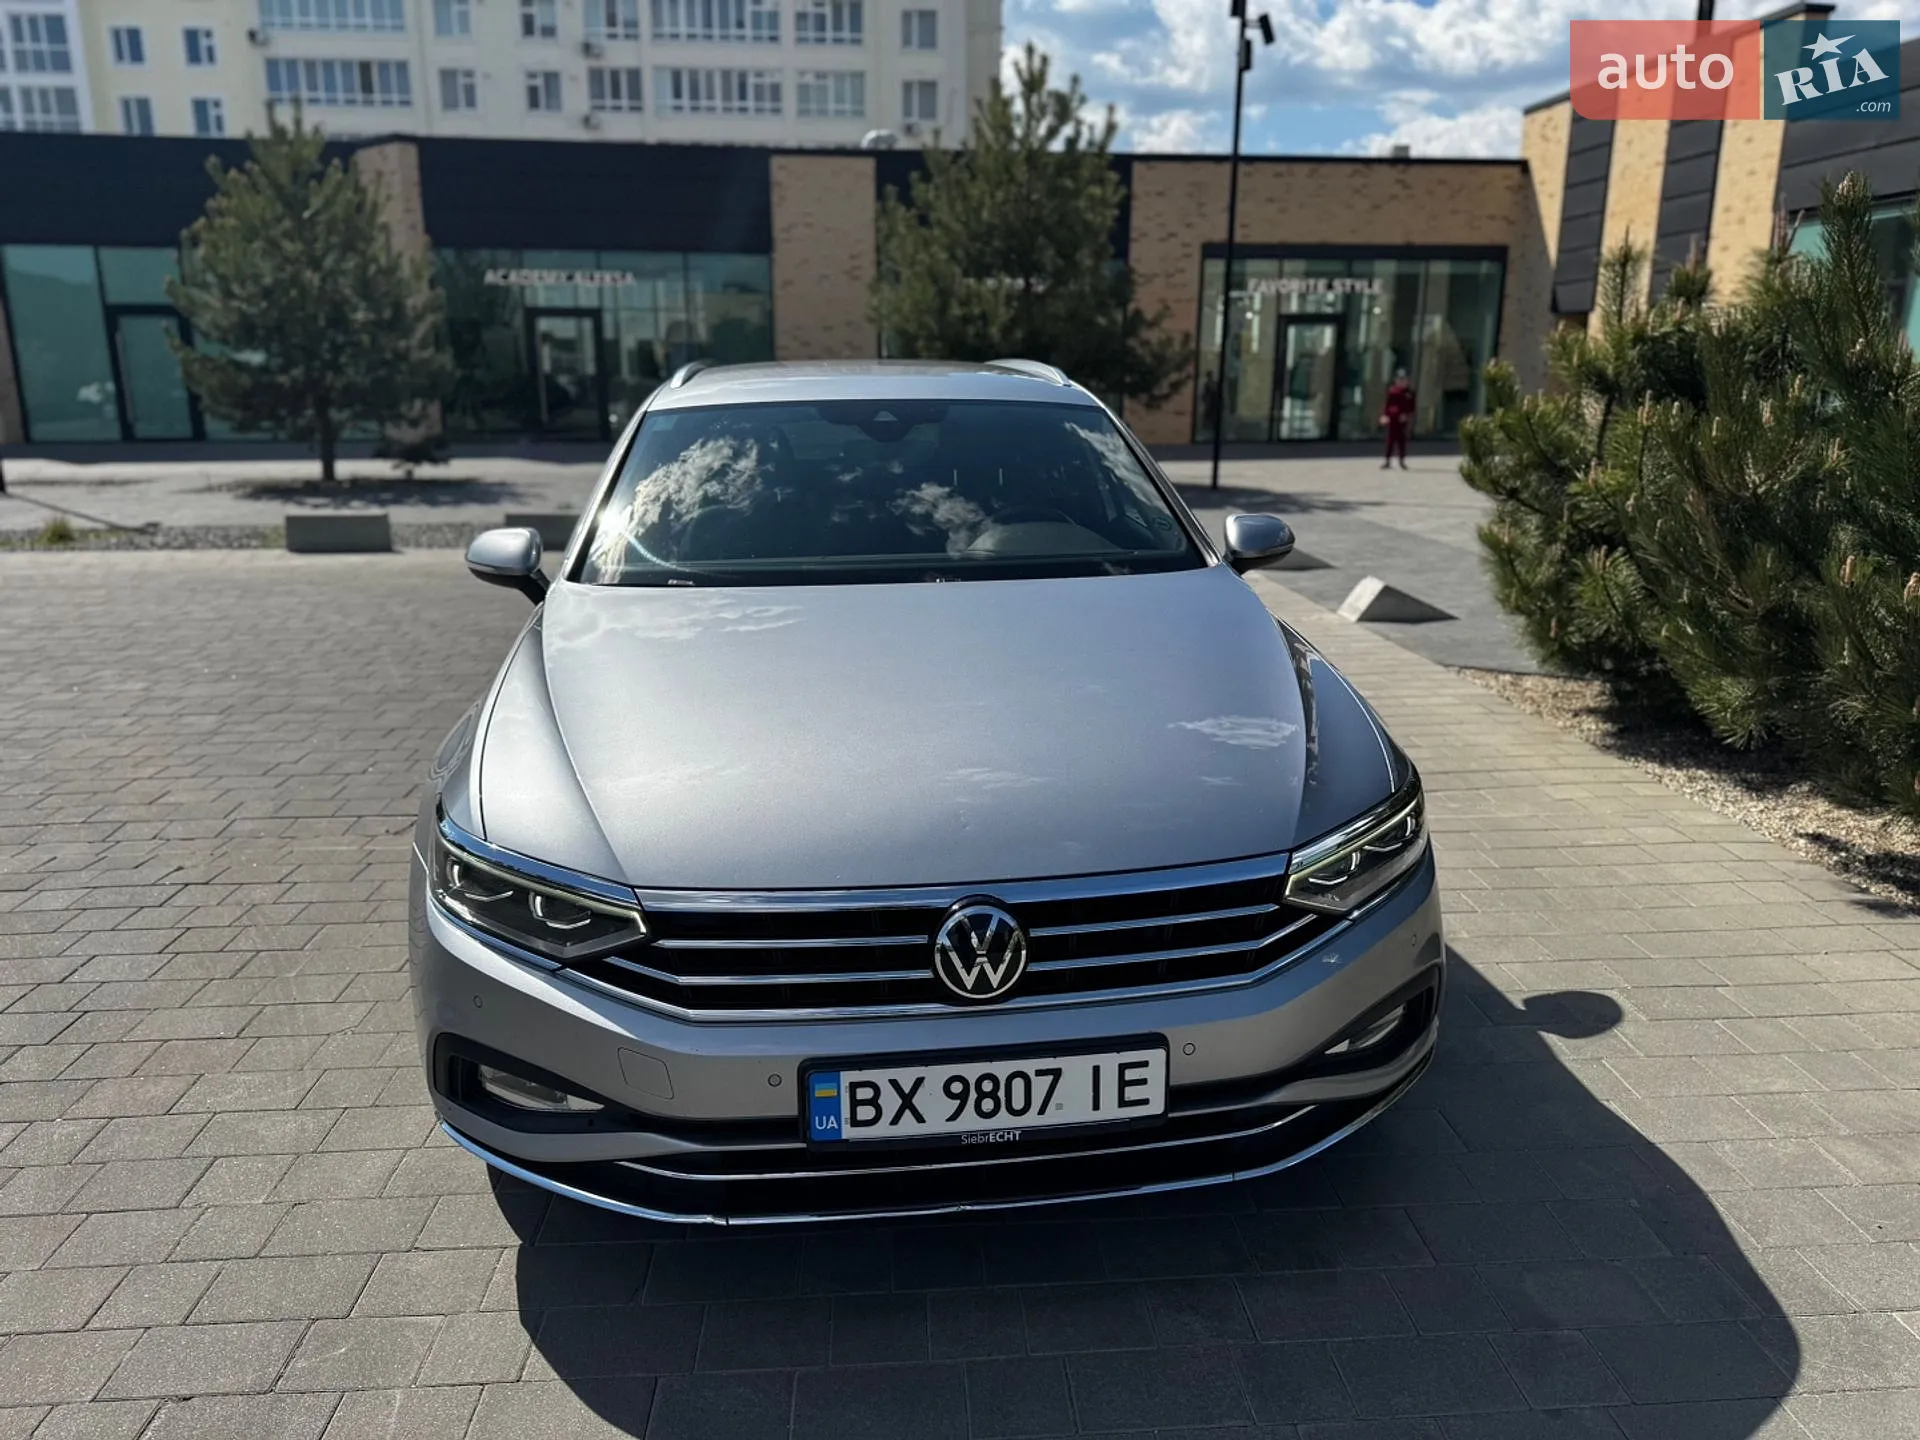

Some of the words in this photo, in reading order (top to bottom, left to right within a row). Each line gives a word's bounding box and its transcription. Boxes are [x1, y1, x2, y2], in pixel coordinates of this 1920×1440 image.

[1248, 278, 1327, 295] FAVORITE
[1331, 278, 1384, 294] STYLE
[815, 1115, 839, 1130] UA
[848, 1076, 927, 1128] BX
[942, 1067, 1063, 1123] 9807
[1091, 1059, 1151, 1112] IE
[961, 1129, 1022, 1145] SiebrECHT
